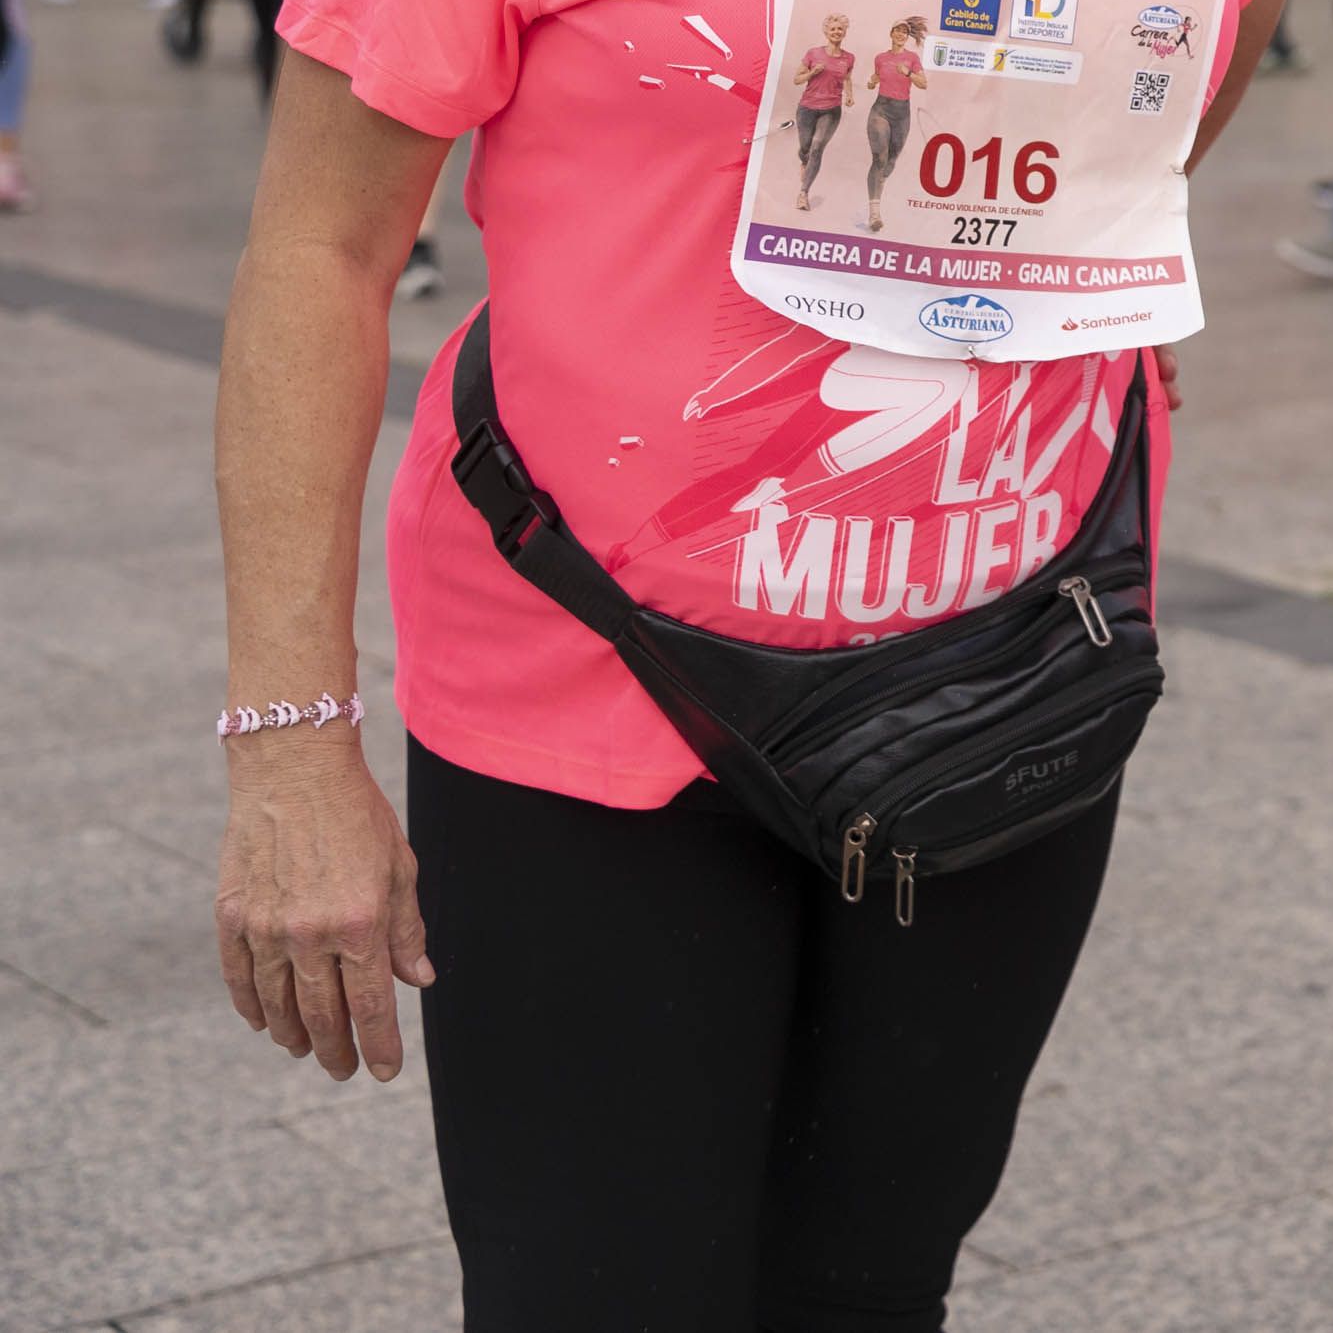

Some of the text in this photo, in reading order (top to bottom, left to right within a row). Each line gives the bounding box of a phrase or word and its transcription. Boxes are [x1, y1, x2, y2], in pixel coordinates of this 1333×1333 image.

[945, 17, 994, 32] Gran Canaria
[949, 8, 990, 22] Cabildo de
[1027, 27, 1065, 39] DEPORTES
[1131, 24, 1168, 40] Carrera
[919, 133, 1060, 204] 016
[907, 199, 1044, 217] TELÉFONO VIOLENCIA DE GÉNERO
[951, 216, 1018, 247] 2377
[759, 233, 1170, 288] CARRERA DE LA MUJER GRAN CANARIA
[784, 293, 865, 322] OYSHO
[926, 307, 1006, 333] ASTURIANA
[1081, 309, 1154, 330] Santander
[732, 489, 1065, 622] MUJER
